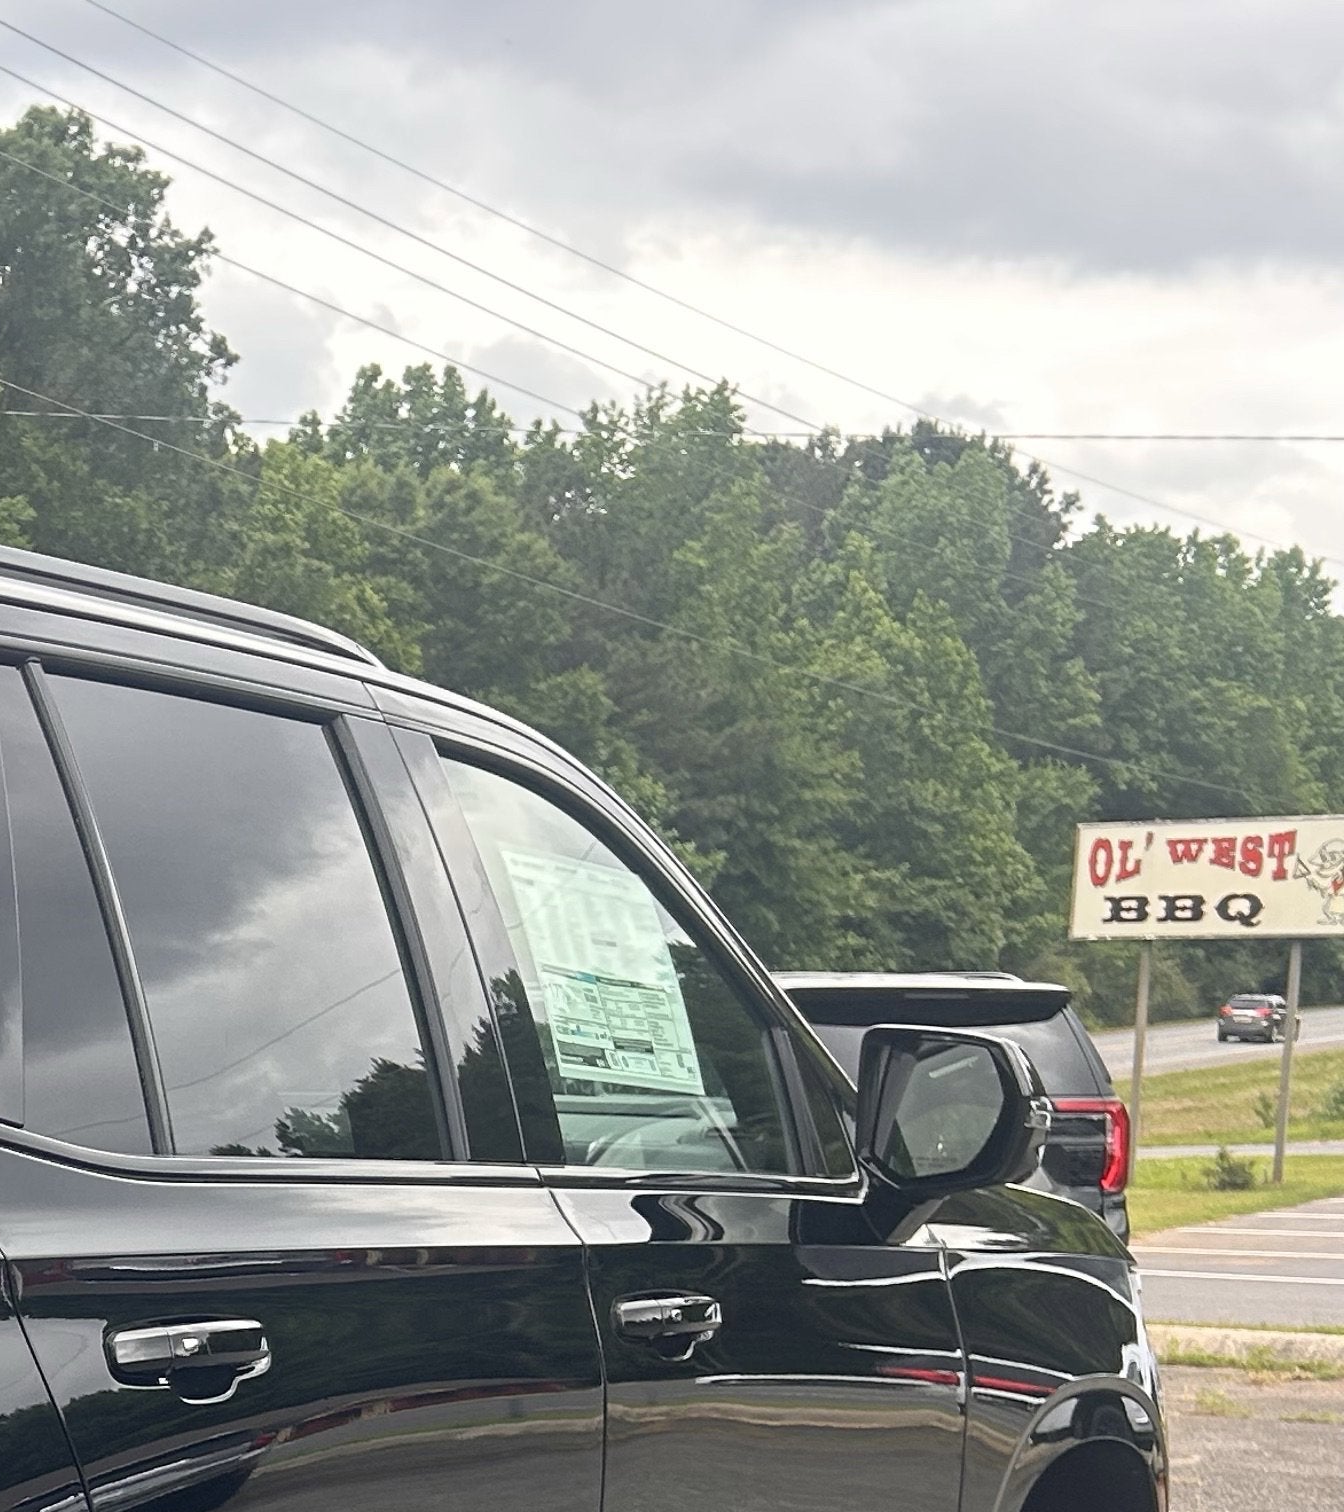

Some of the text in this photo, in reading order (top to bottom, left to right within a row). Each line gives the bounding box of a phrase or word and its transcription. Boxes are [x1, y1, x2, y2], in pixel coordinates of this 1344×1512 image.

[1088, 829, 1298, 888] OL' WEST
[1102, 892, 1265, 927] BBQ
